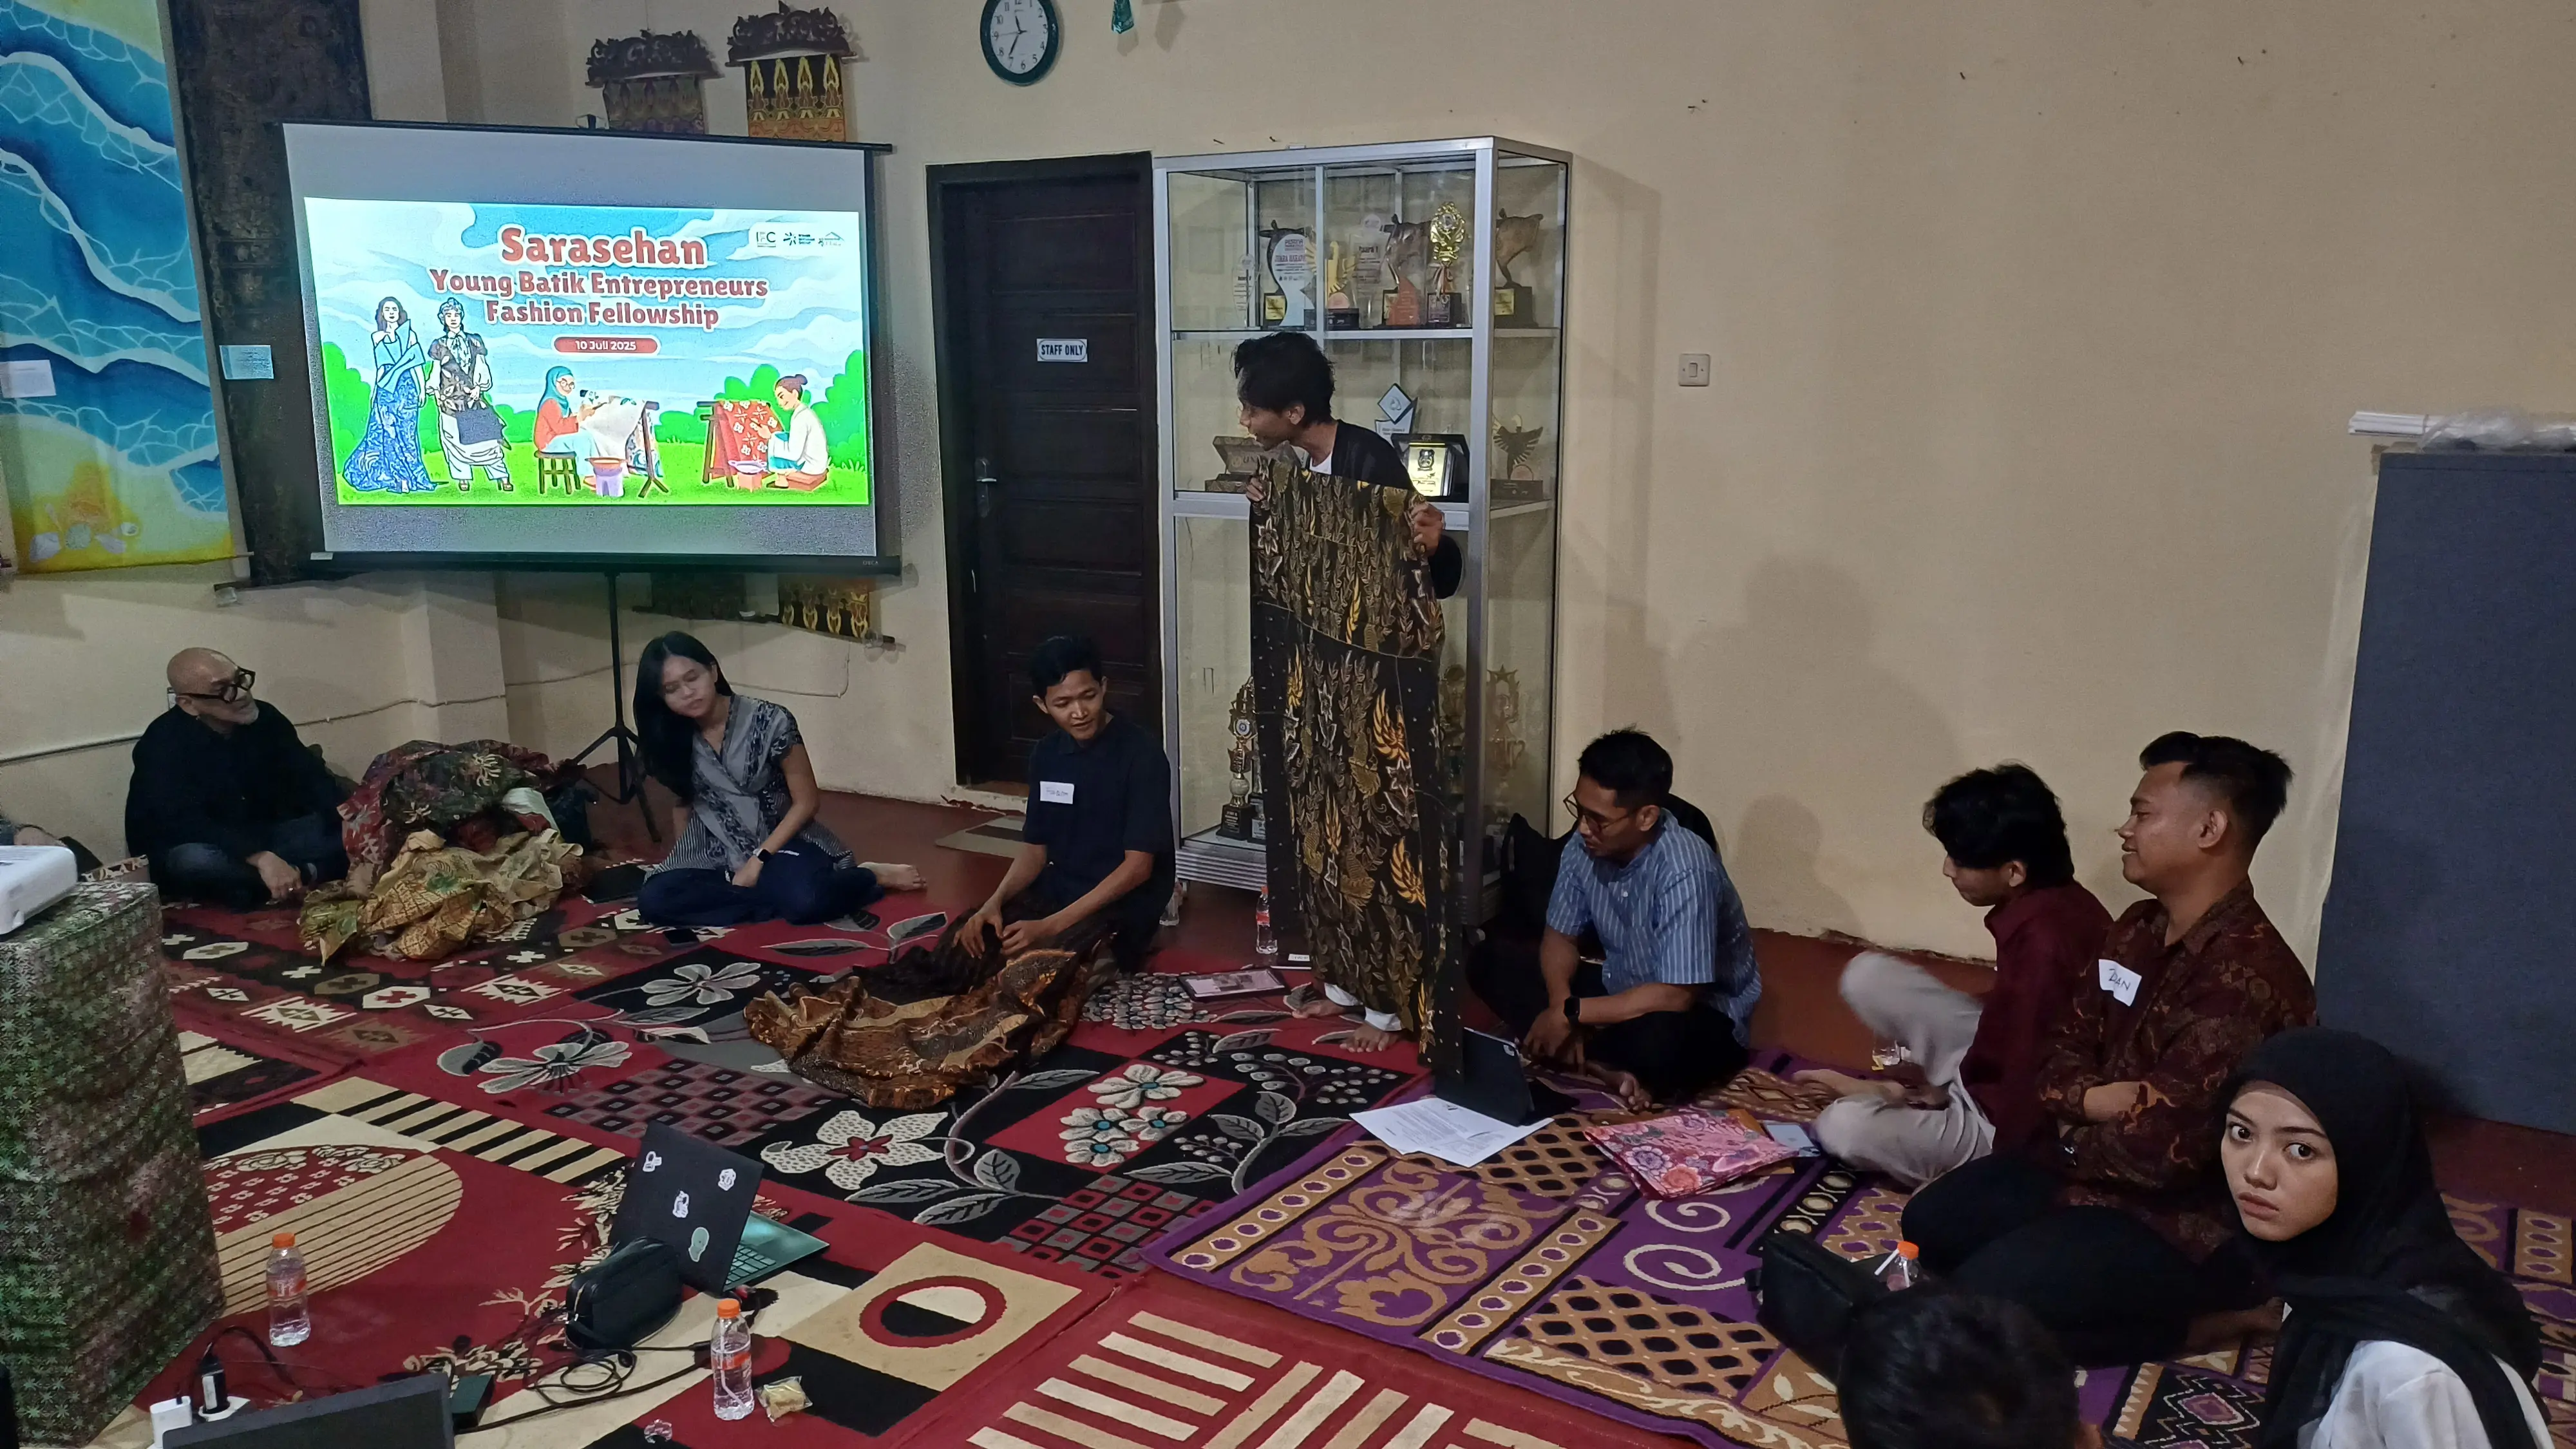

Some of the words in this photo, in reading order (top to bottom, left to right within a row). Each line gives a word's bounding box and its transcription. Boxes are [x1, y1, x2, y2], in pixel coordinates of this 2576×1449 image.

[1038, 7, 1043, 18] 2
[1043, 24, 1048, 34] 3
[1040, 41, 1045, 50] 4
[1032, 53, 1037, 64] 5
[1021, 60, 1026, 70] 6
[501, 227, 705, 265] Sarasehan
[430, 269, 513, 297] Young
[518, 270, 585, 294] Batik
[591, 272, 768, 299] Entrepreneurs
[486, 299, 583, 322] Fashion
[589, 302, 719, 330] Fellowship
[575, 340, 588, 350] 10
[589, 340, 609, 350] Juli
[611, 341, 636, 350] 2025
[1041, 345, 1063, 355] STAFF
[1065, 345, 1083, 355] ONLY
